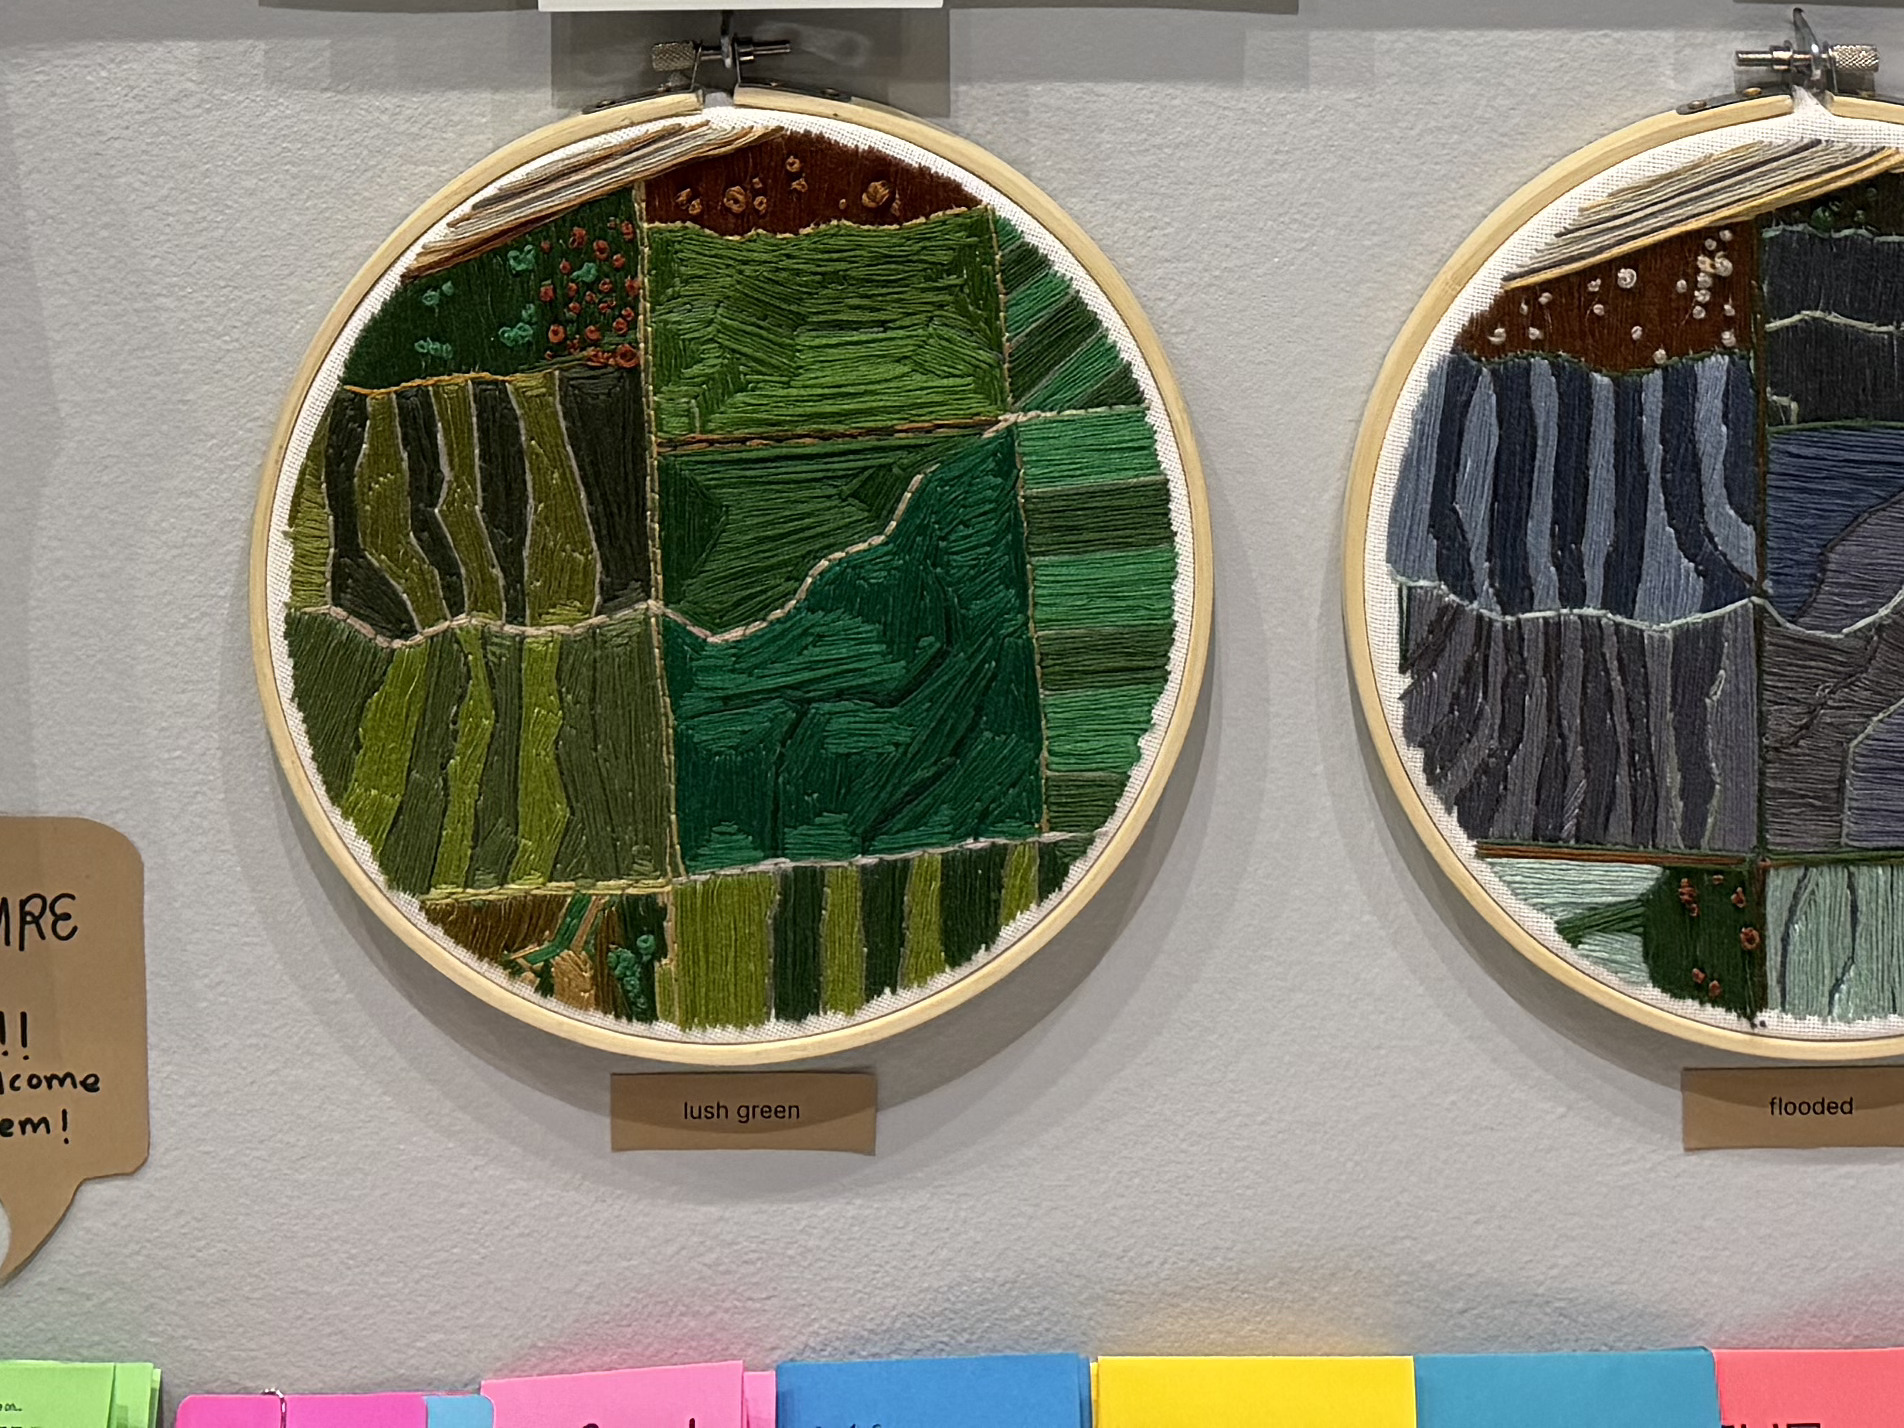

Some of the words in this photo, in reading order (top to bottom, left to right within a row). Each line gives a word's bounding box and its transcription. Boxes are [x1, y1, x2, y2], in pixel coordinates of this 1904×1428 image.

[685, 1102, 728, 1119] lush
[737, 1105, 799, 1123] green
[1770, 1097, 1853, 1115] flooded
